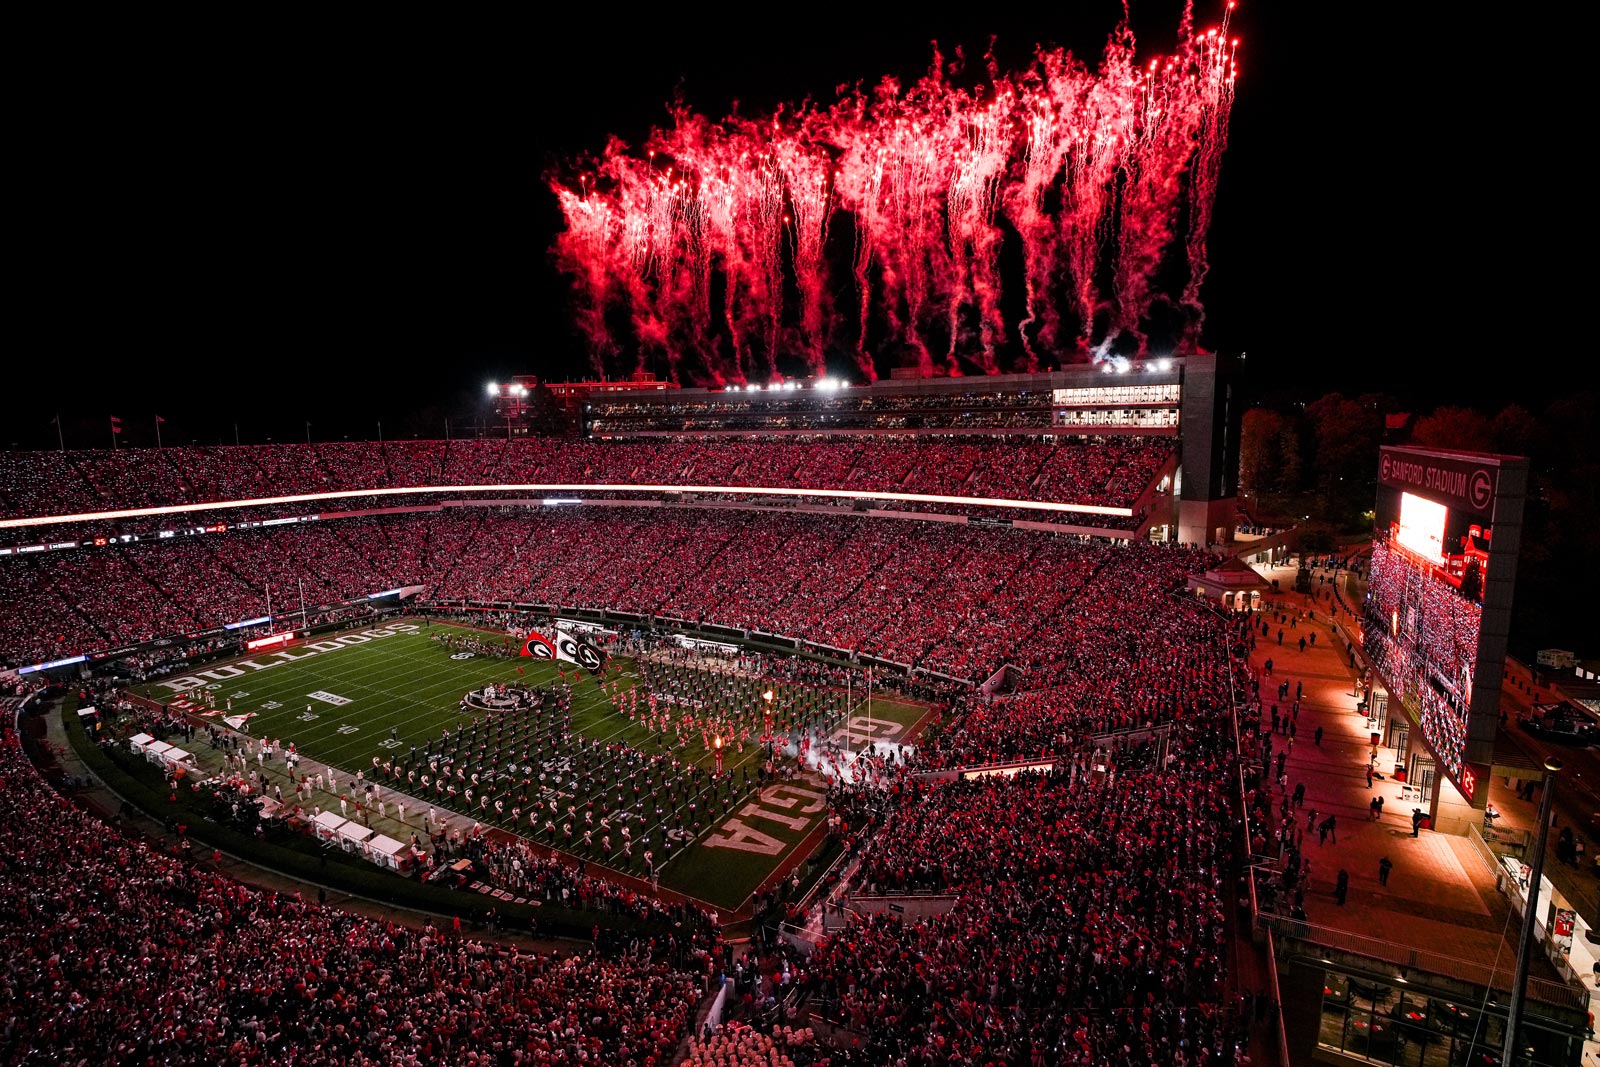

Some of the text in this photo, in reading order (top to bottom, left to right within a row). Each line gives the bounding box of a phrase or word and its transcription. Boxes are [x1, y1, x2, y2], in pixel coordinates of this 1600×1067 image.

[1391, 460, 1423, 485] SANFORD
[1425, 467, 1467, 497] STADIUM
[1469, 470, 1491, 510] G
[156, 623, 420, 692] BULLDOGS
[378, 739, 403, 749] 50
[701, 716, 903, 856] GERGIA
[1465, 771, 1474, 793] 25
[1562, 923, 1570, 932] 11
